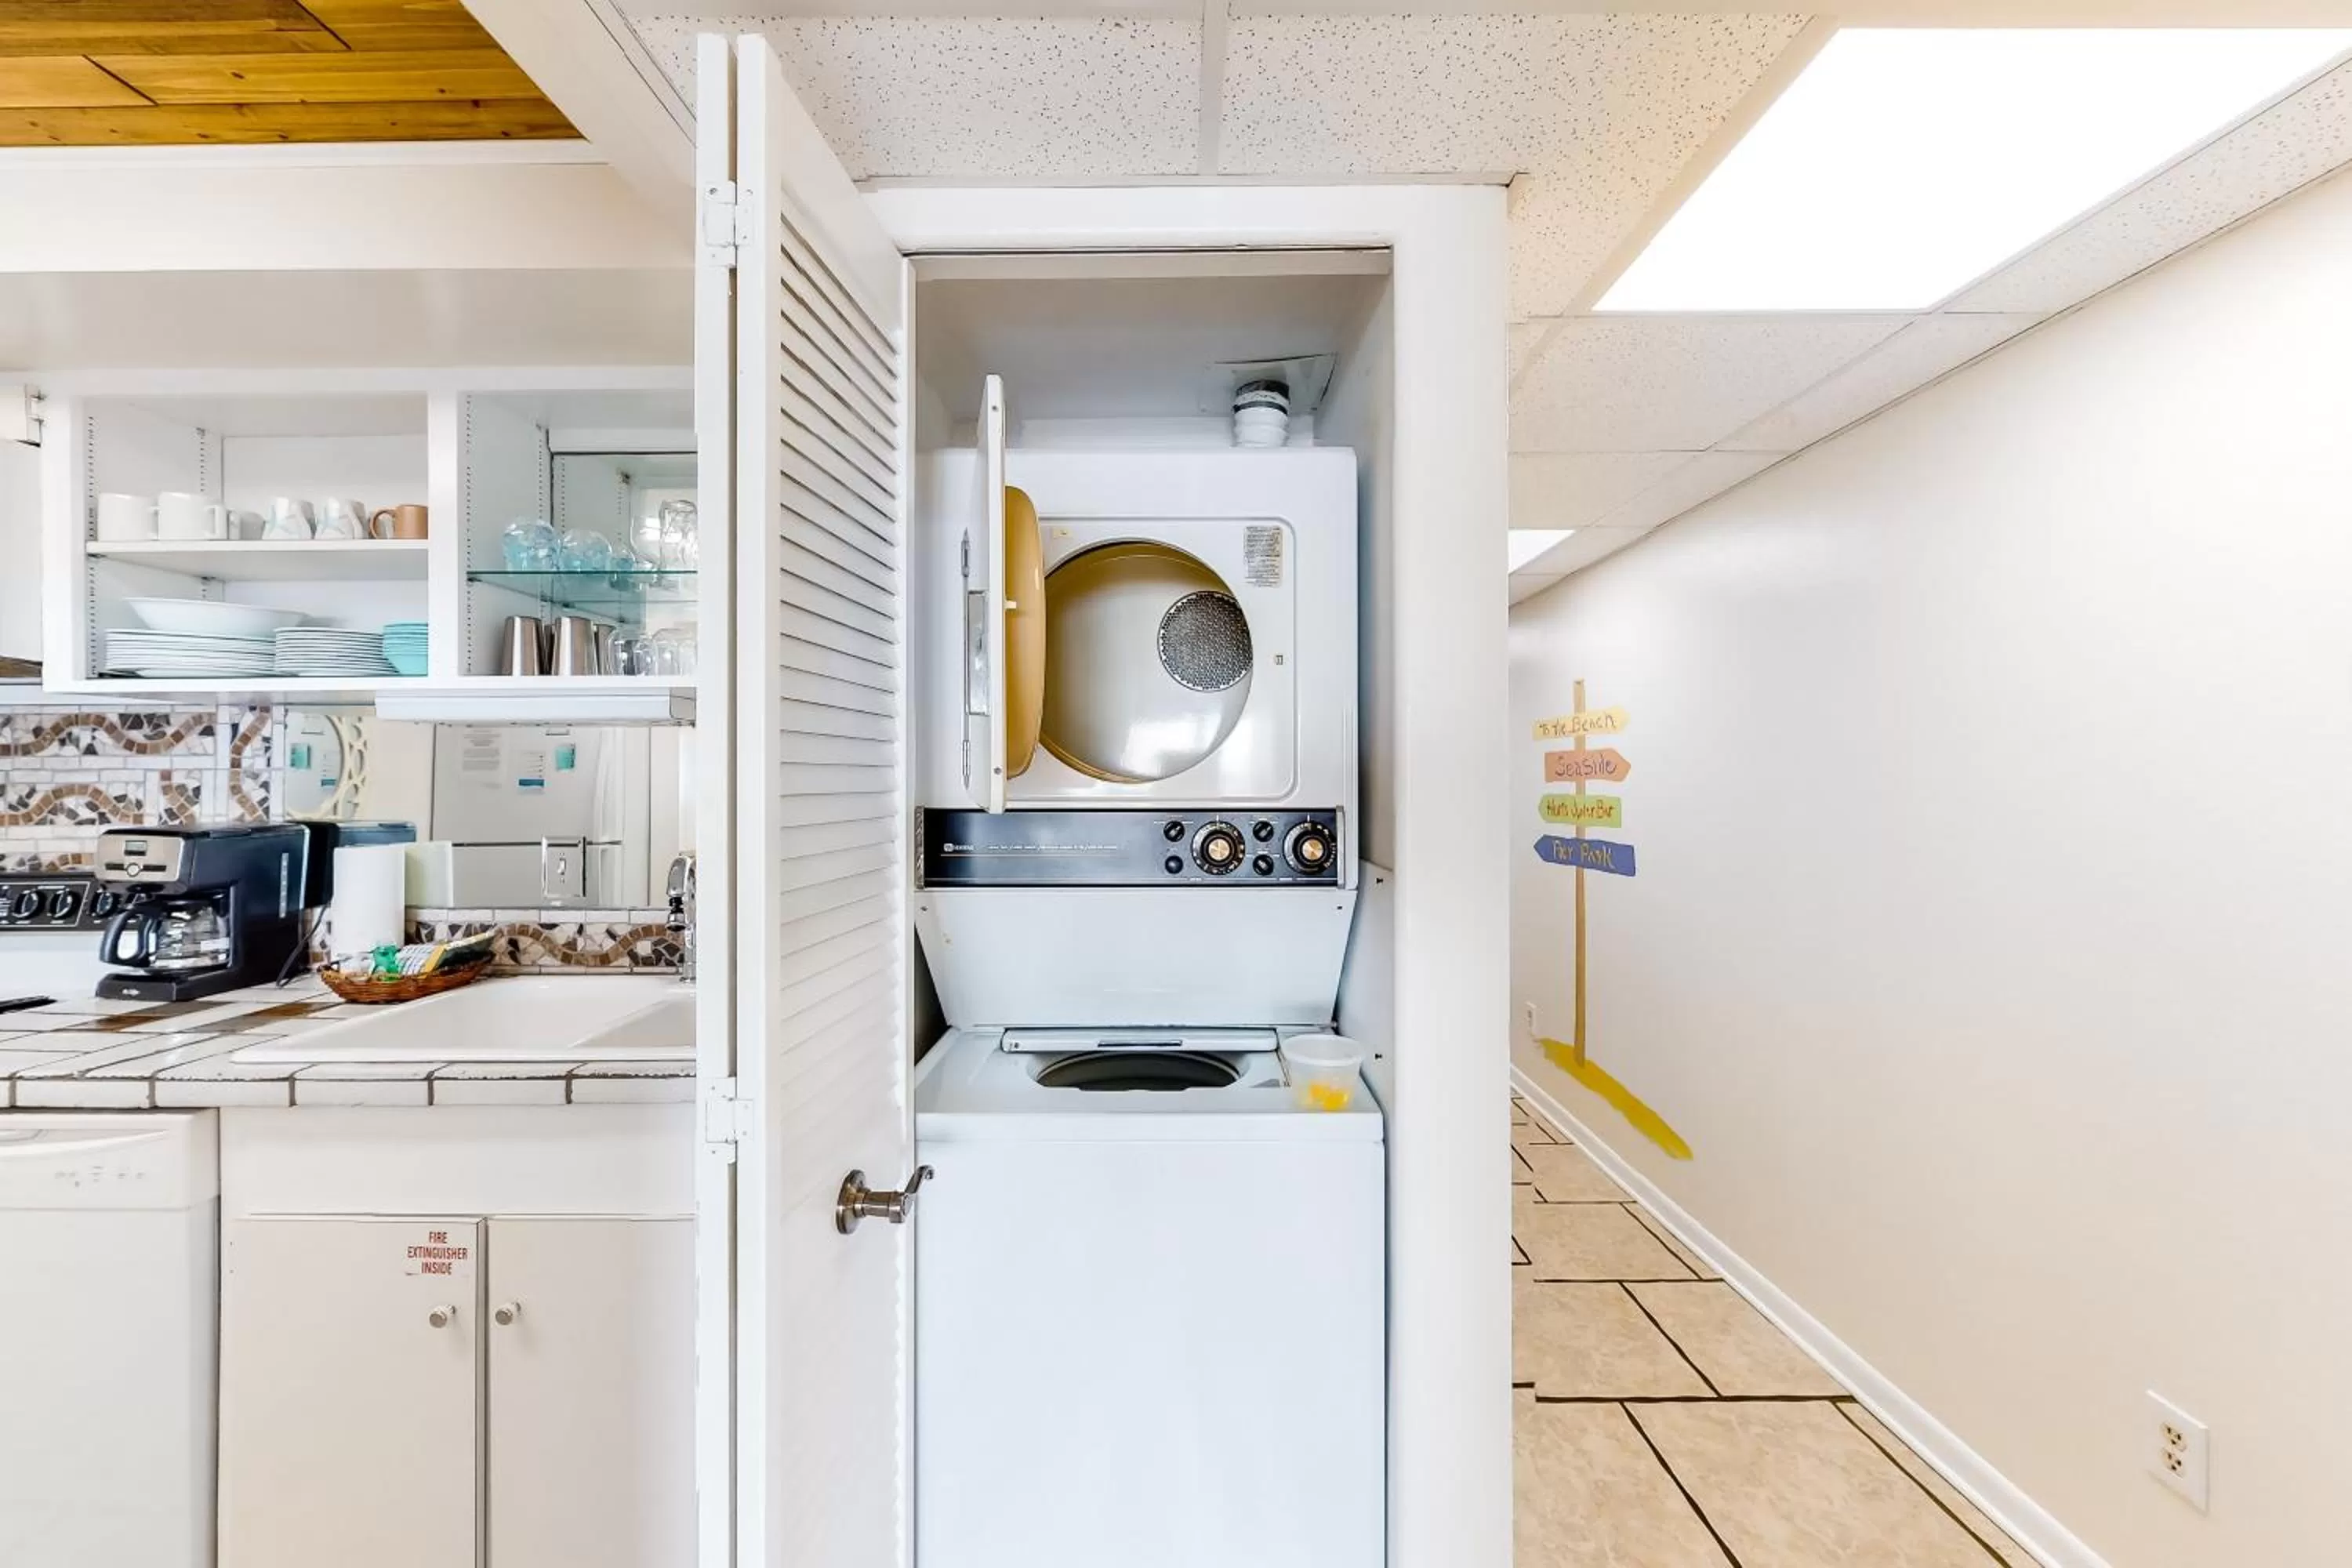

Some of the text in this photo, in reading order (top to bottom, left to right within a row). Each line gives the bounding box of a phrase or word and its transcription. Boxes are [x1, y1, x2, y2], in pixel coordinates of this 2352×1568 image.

[1539, 723, 1550, 735] To
[429, 1231, 448, 1244] FIRE
[407, 1245, 469, 1261] EXTINGUISHER
[421, 1261, 452, 1275] INSIDE
